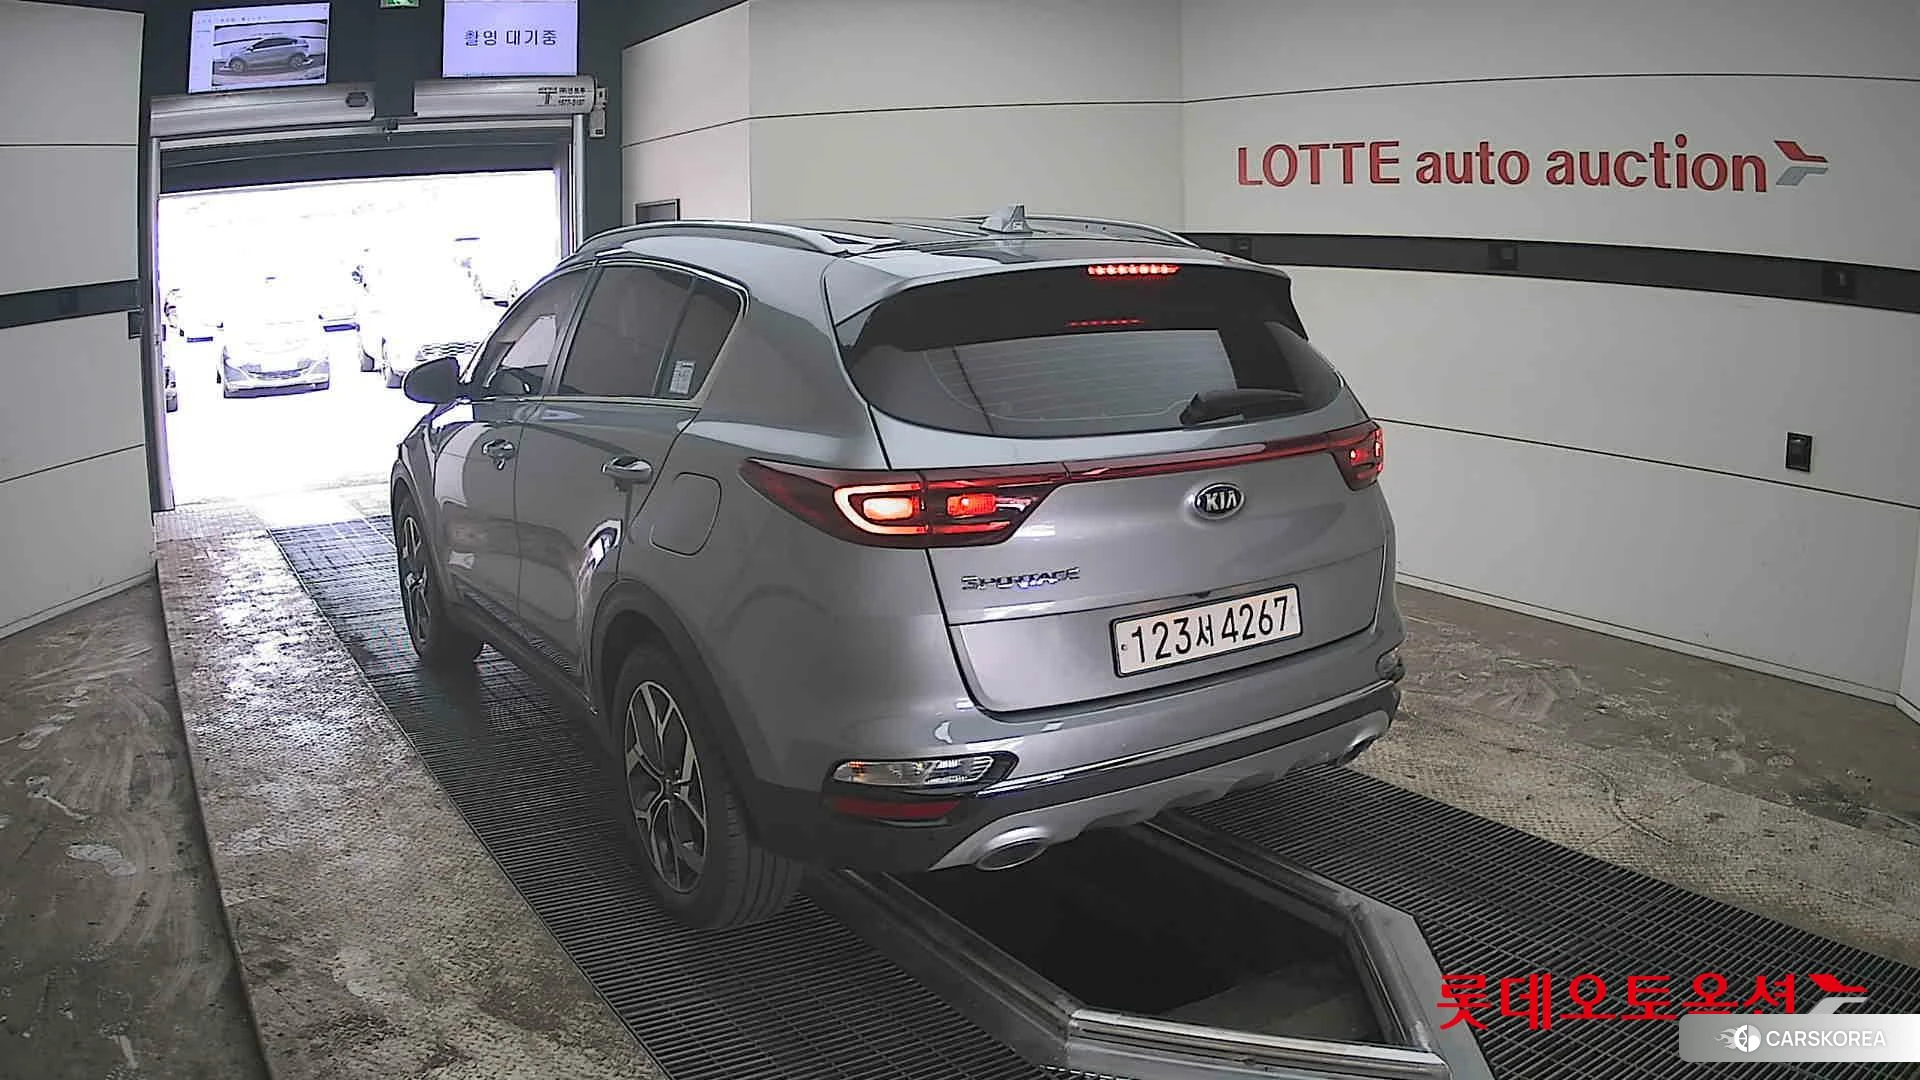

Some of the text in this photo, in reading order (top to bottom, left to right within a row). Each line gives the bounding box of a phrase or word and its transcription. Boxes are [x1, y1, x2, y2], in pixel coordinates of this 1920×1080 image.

[504, 29, 557, 46] 대기중
[1237, 134, 1768, 193] LOTTE auto auction
[1205, 490, 1238, 511] KIA
